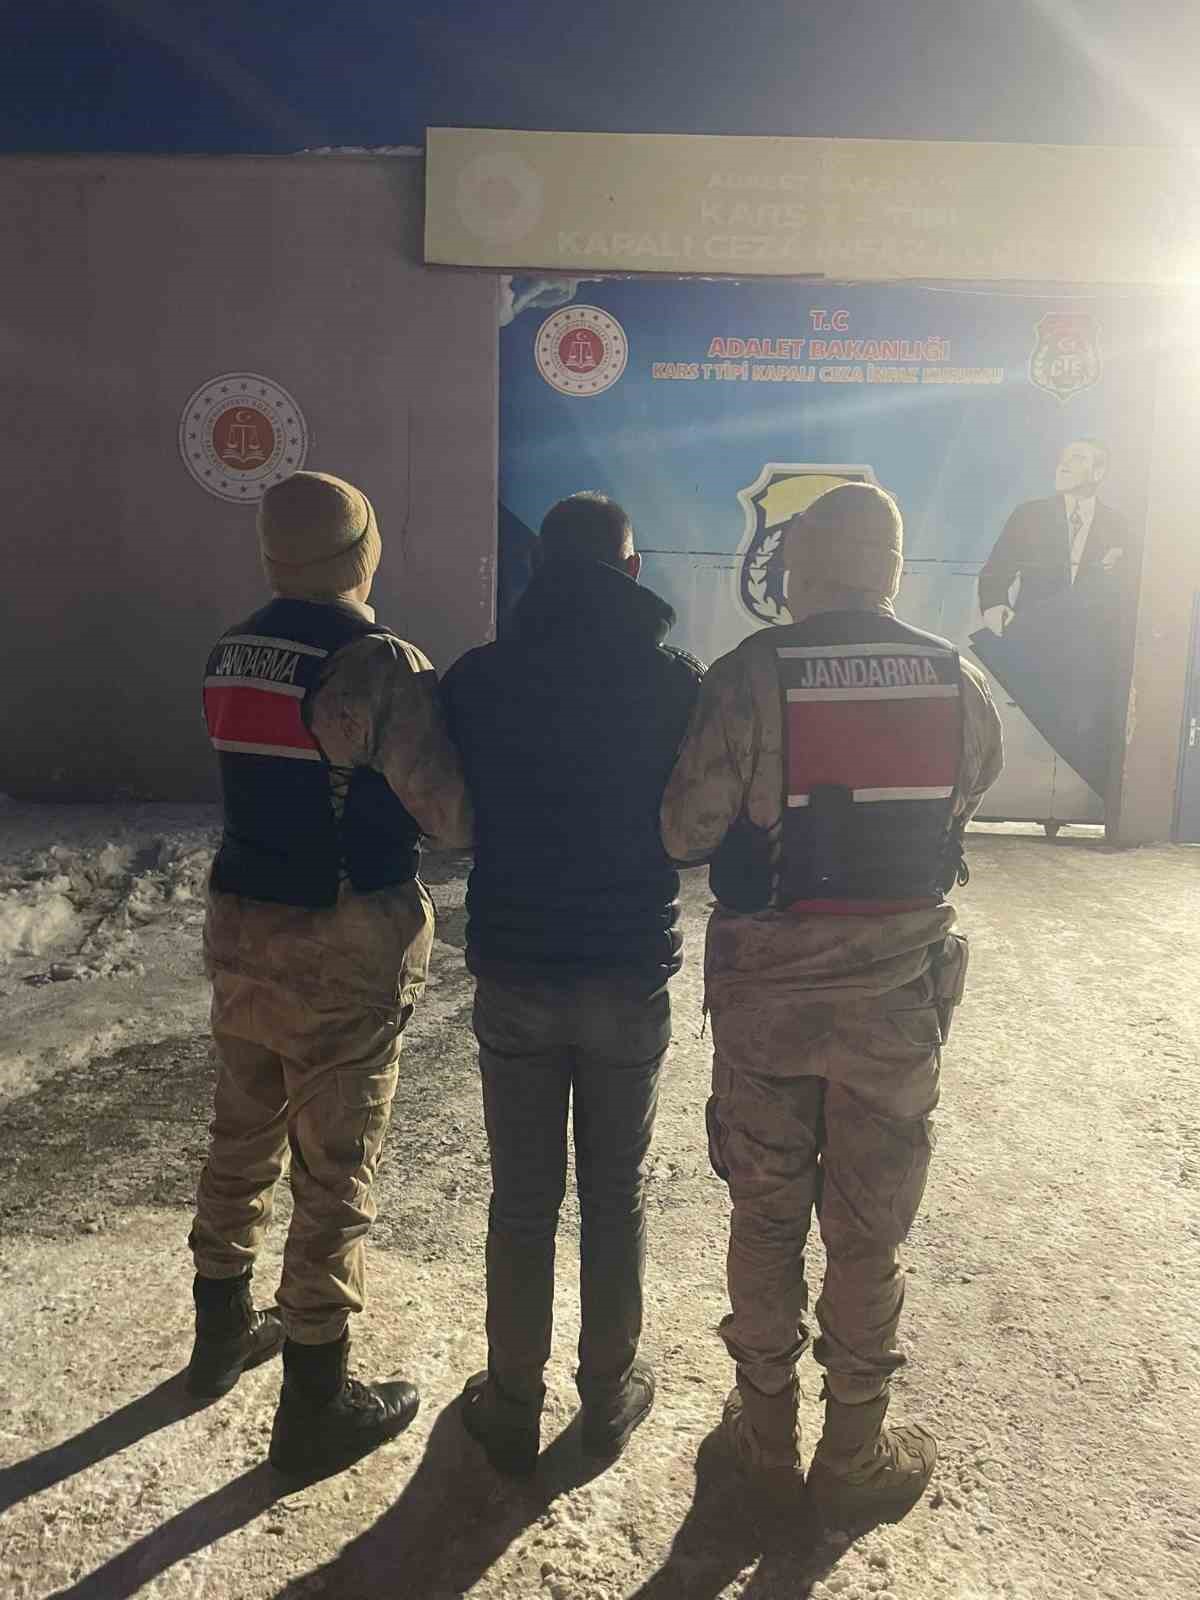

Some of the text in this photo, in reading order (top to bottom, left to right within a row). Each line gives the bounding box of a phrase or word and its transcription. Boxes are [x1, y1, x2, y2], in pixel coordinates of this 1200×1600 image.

[707, 336, 806, 359] ADALET
[652, 362, 701, 380] KARS
[801, 656, 938, 688] JANDARMA
